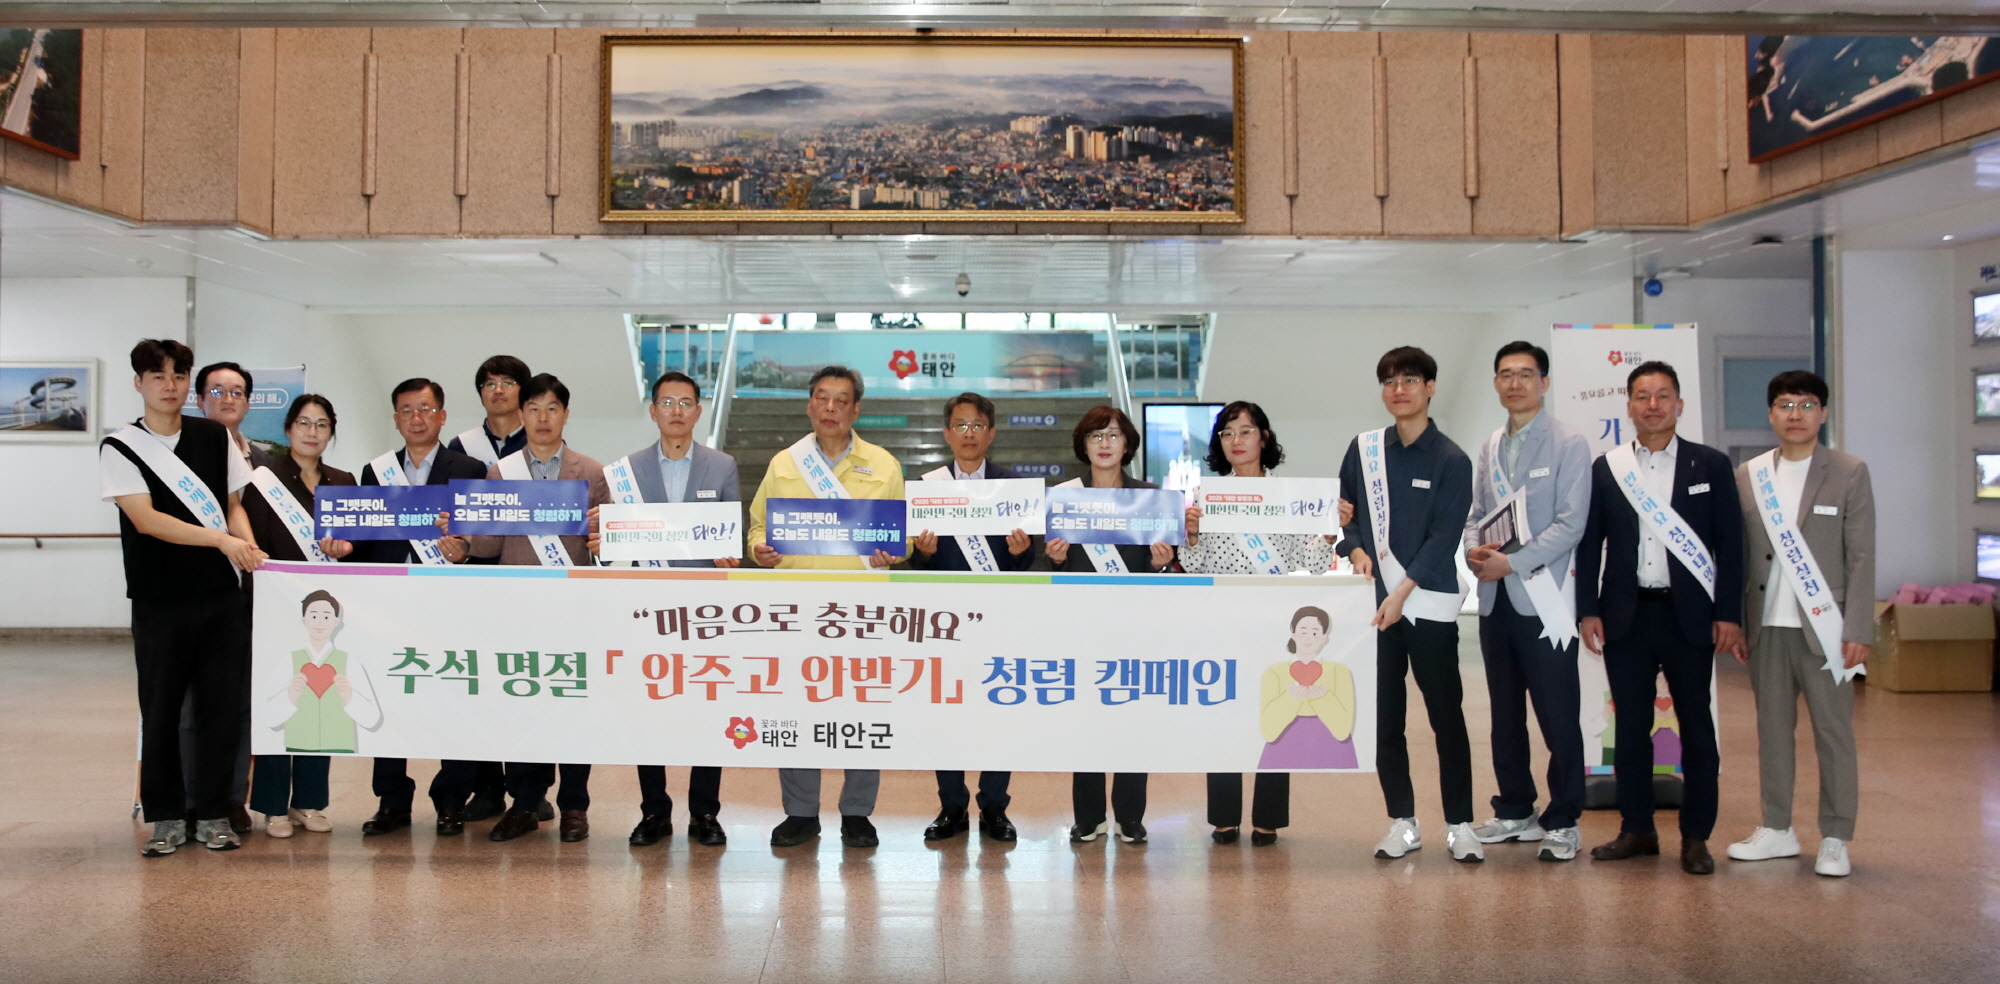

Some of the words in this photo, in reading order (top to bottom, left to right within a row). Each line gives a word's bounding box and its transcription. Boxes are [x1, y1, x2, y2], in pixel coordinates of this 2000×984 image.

[922, 361, 956, 378] 태안
[320, 498, 333, 512] 늘
[454, 492, 467, 505] 늘
[454, 508, 491, 522] 오늘도
[493, 508, 530, 522] 내일도
[533, 508, 583, 522] 청렴하게
[912, 507, 967, 519] 대한민국의
[970, 506, 993, 519] 정원
[996, 498, 1040, 518] 태안!
[1051, 501, 1064, 514] 늘
[1205, 504, 1260, 516] 대한민국의
[1263, 504, 1286, 516] 정원
[1290, 498, 1334, 517] 태안!
[320, 514, 357, 527] 오늘도
[359, 514, 395, 527] 내일도
[772, 511, 785, 525] 늘
[1051, 516, 1088, 530] 오늘도
[1090, 517, 1127, 531] 내일도
[1130, 518, 1179, 531] 청렴하게
[606, 530, 663, 543] 대한민국의
[666, 530, 689, 542] 정원
[692, 522, 736, 541] 태안!
[772, 528, 809, 542] 오늘도
[812, 528, 849, 542] 내일도
[852, 528, 900, 543] 청렴하게
[1778, 529, 1821, 598] 청렴실천
[386, 646, 479, 695] 추석
[494, 650, 588, 698] 명절
[801, 654, 963, 704] 안받기」
[981, 656, 1075, 706] 청렴
[1095, 658, 1237, 706] 캠페인
[761, 719, 778, 729] 꽃과
[781, 719, 798, 729] 바다
[762, 730, 798, 747] 태안
[814, 721, 893, 749] 태안군
